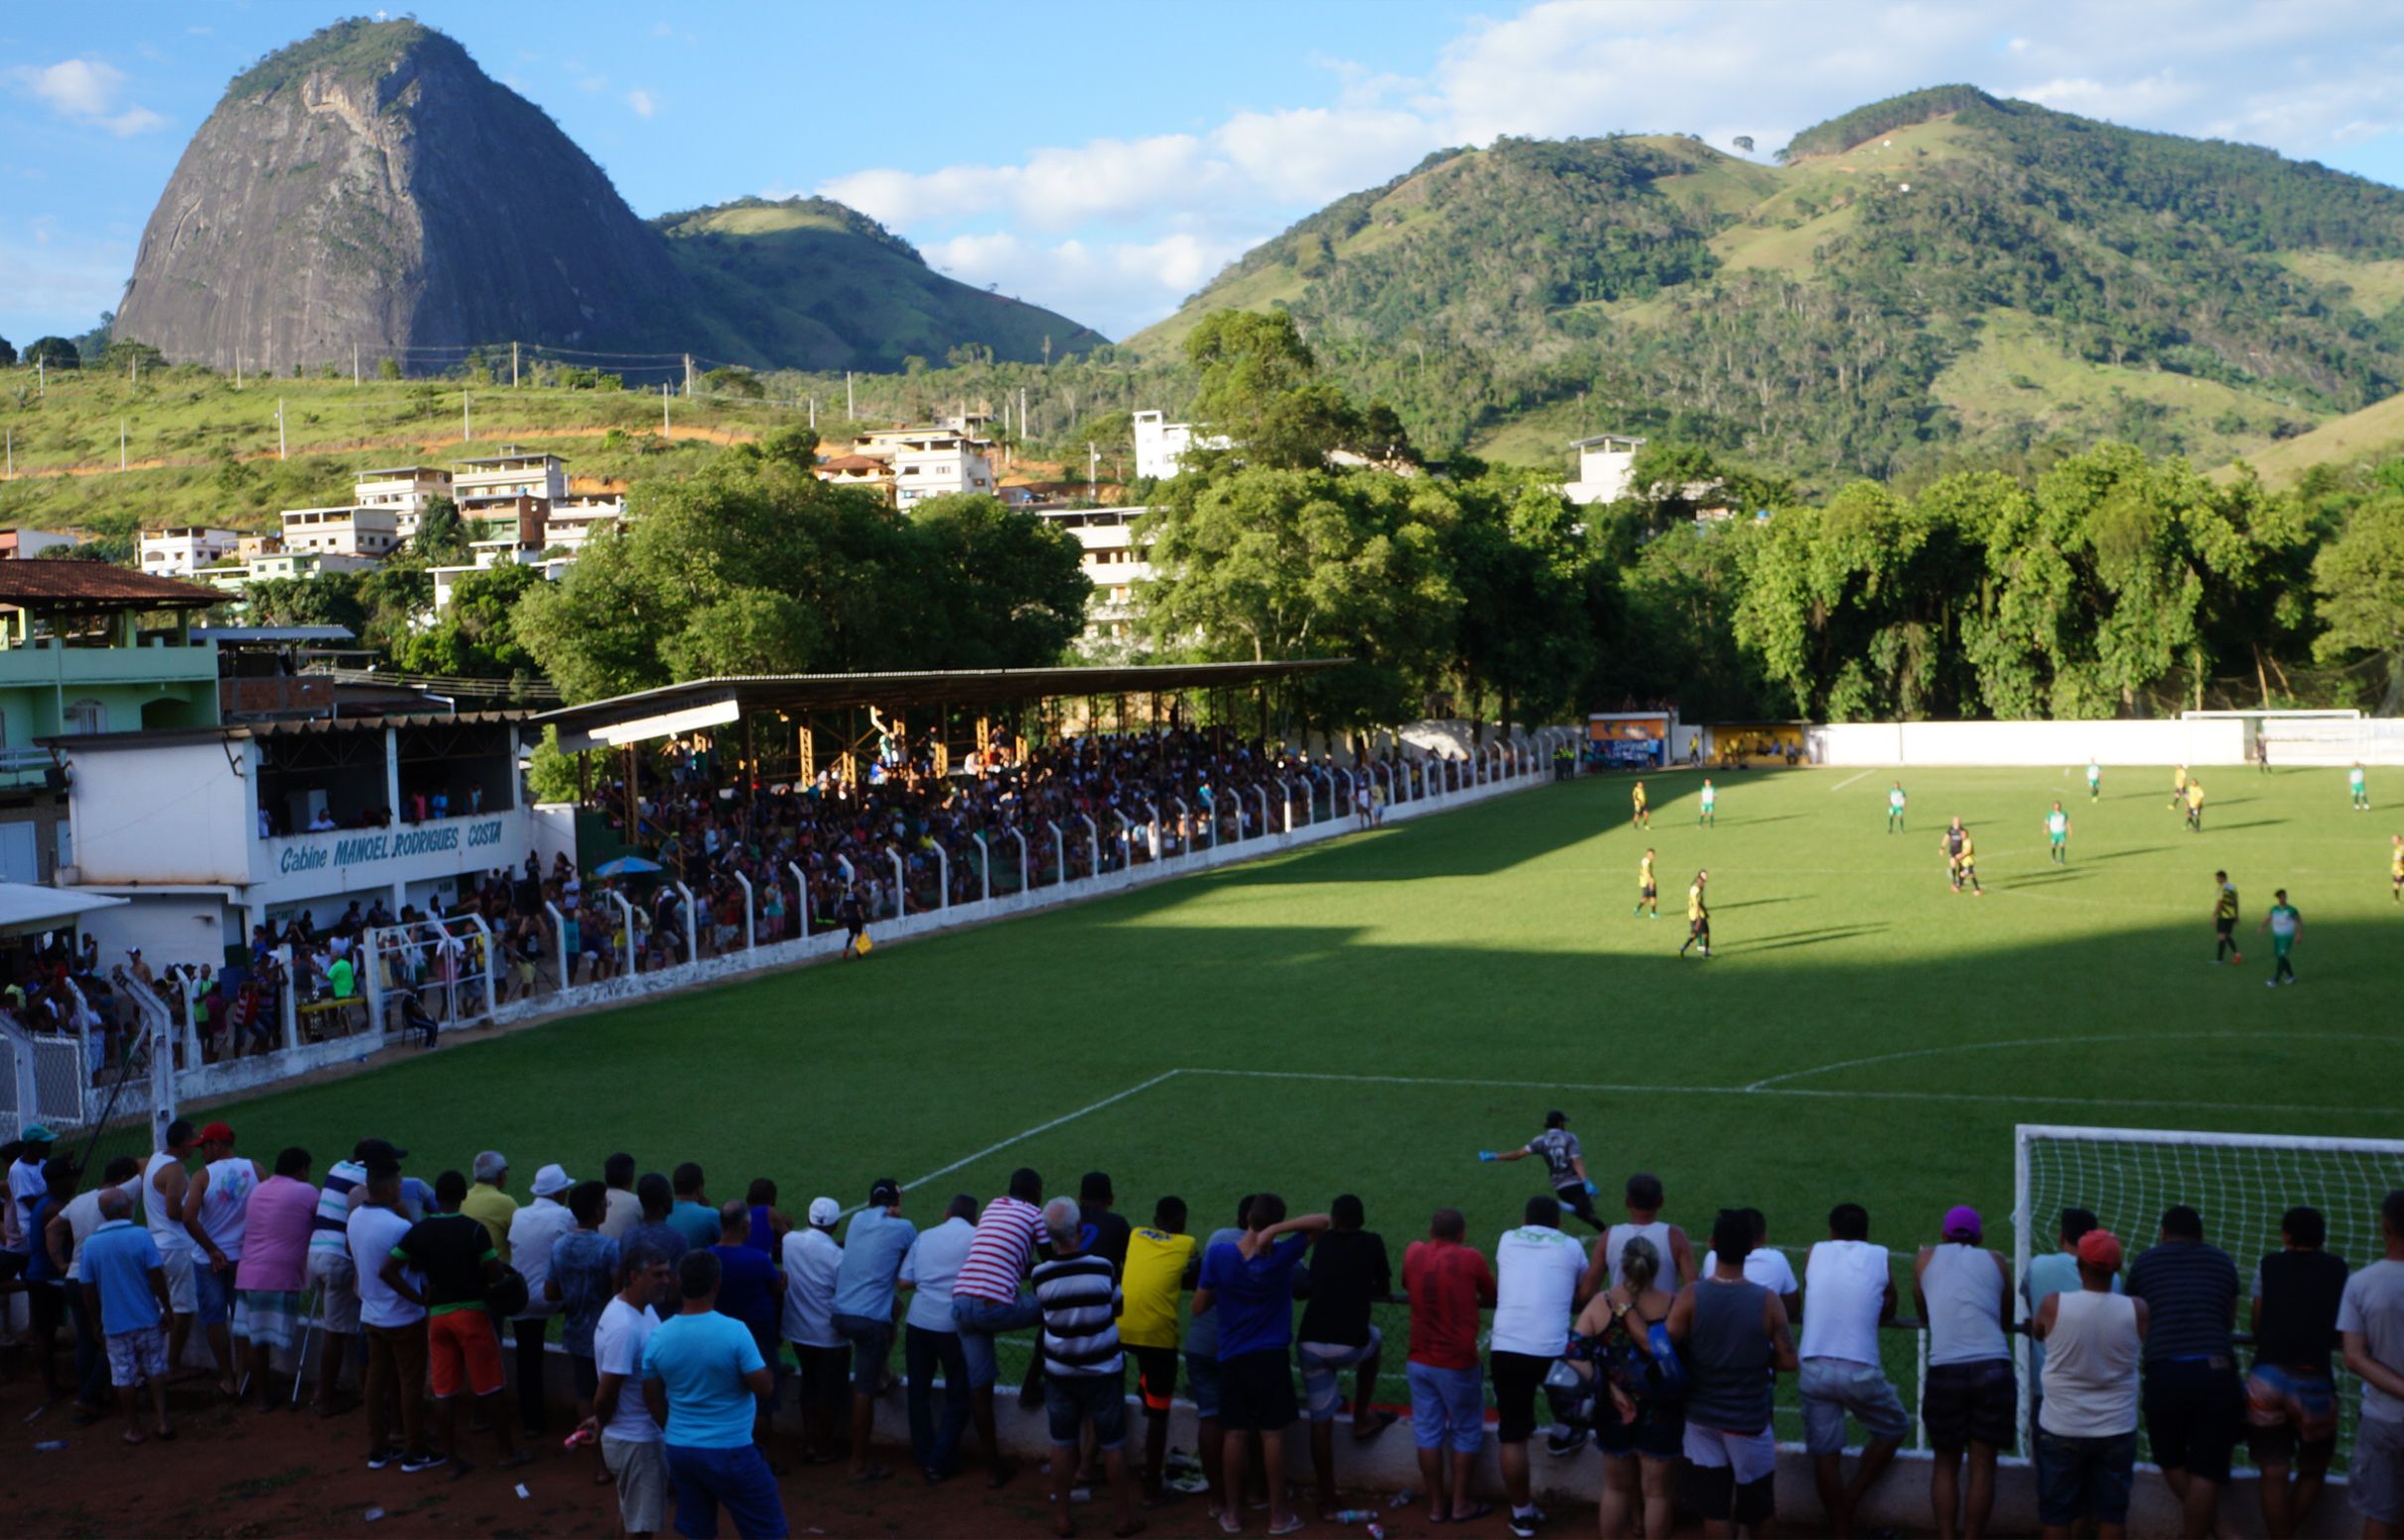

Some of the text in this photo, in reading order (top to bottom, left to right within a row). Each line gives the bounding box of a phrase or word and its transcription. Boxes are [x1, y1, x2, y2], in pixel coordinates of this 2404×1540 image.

[281, 821, 502, 873] Cabine MANOEL RODRIGUES COSTA
